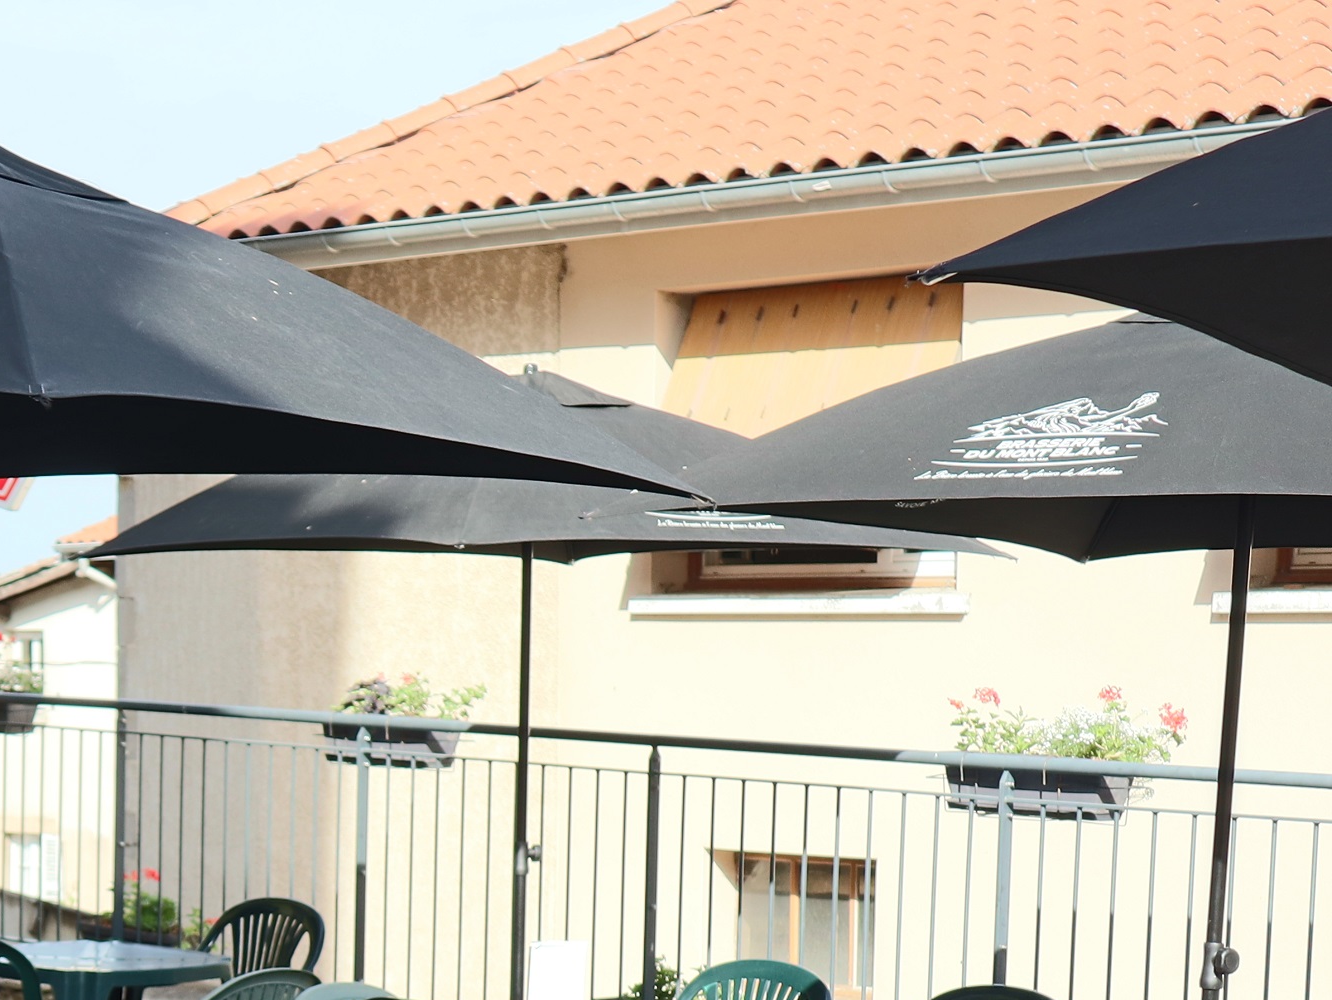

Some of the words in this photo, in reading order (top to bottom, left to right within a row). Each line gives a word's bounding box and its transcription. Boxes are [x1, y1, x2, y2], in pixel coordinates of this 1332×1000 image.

[996, 437, 1106, 450] BRASSERIE
[963, 449, 996, 459] DU
[994, 447, 1055, 459] MONT
[1049, 446, 1120, 458] BLANC
